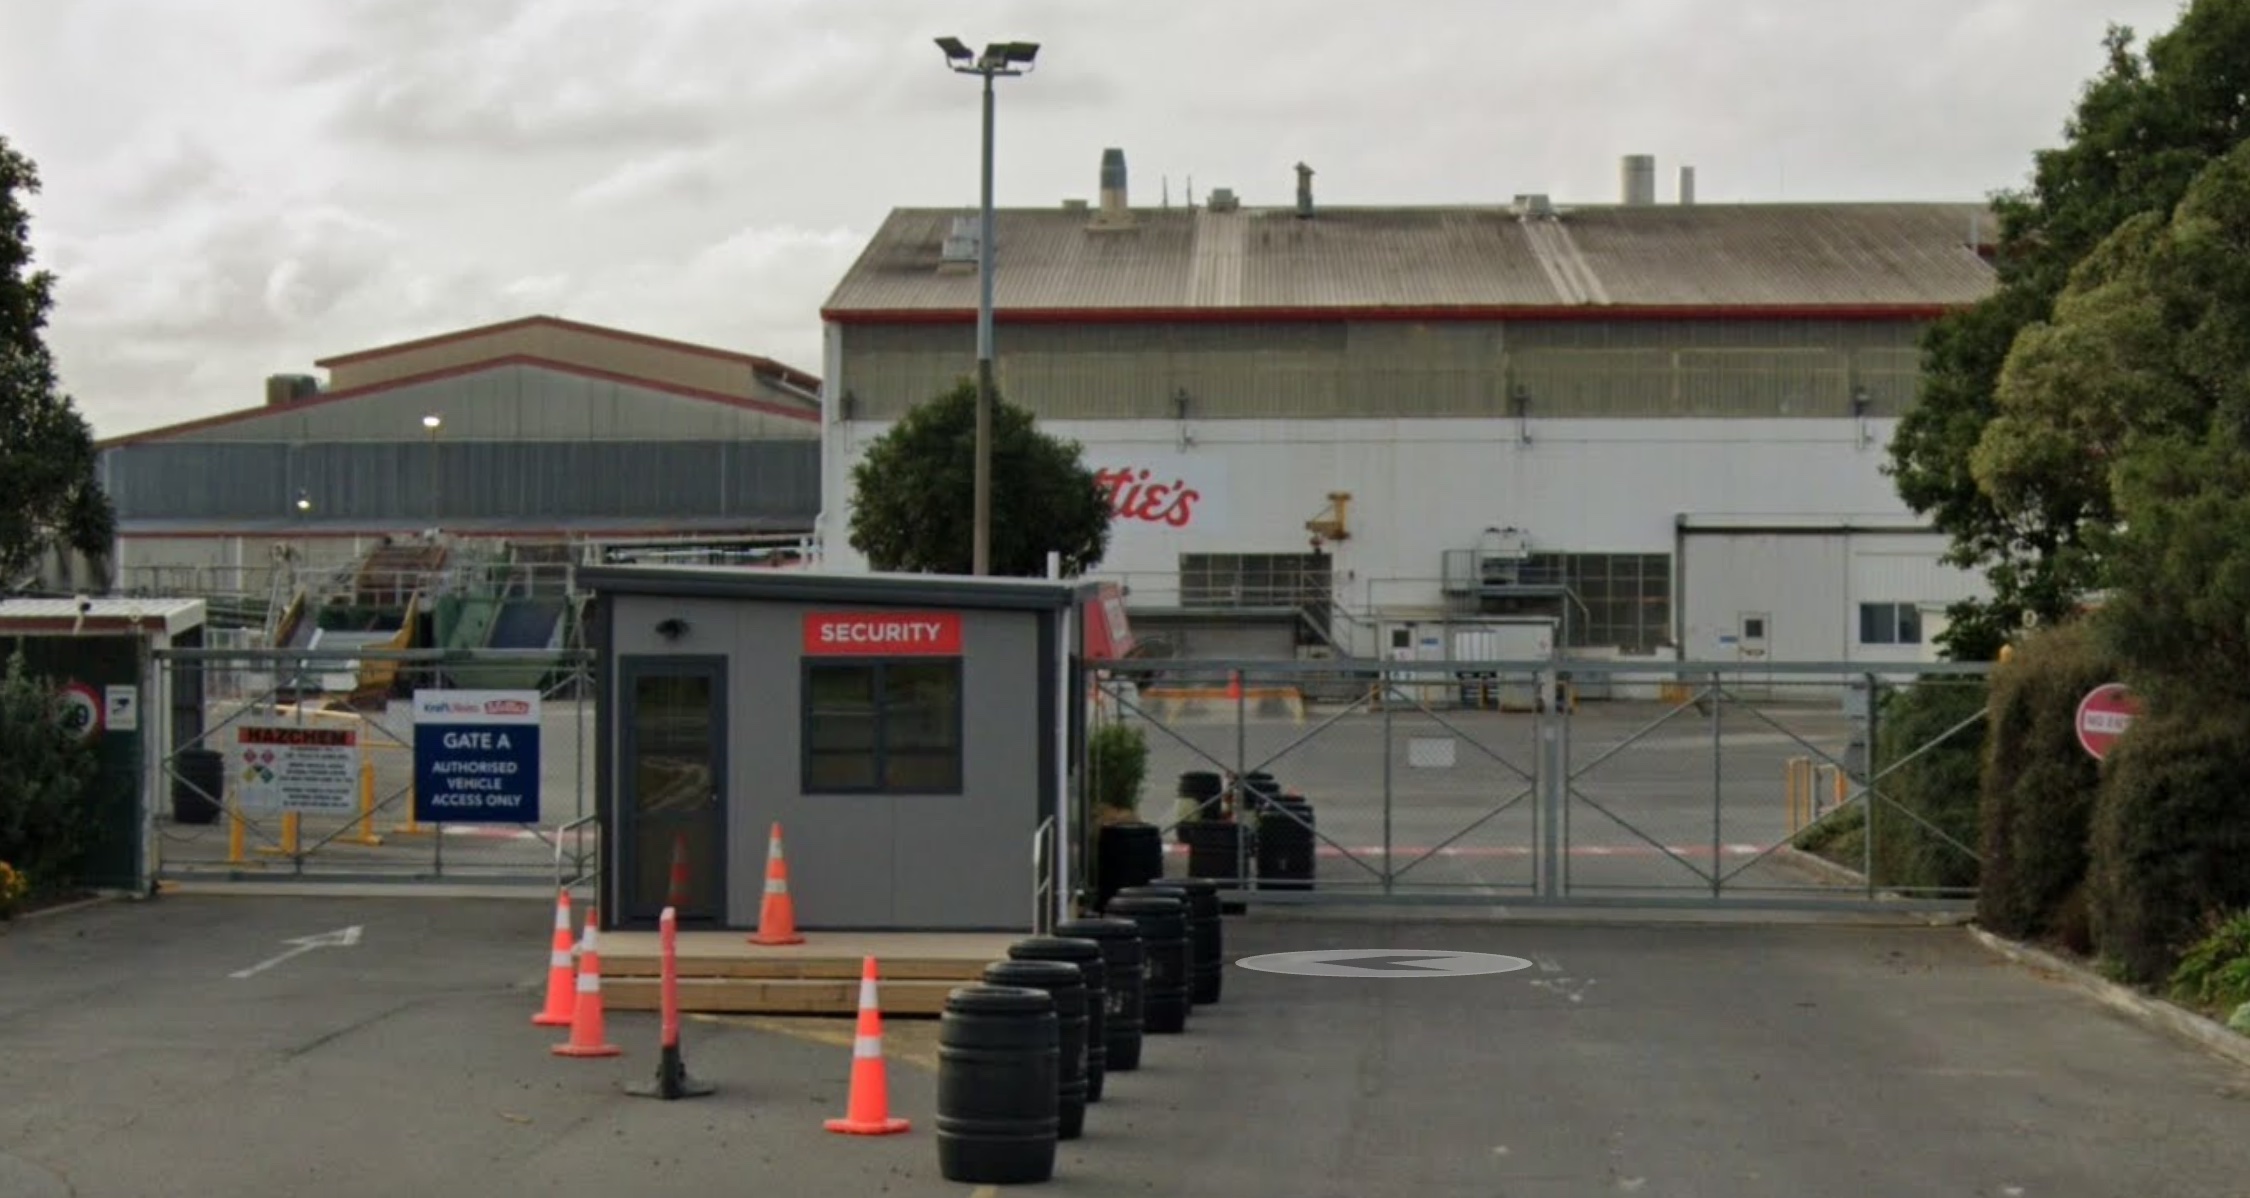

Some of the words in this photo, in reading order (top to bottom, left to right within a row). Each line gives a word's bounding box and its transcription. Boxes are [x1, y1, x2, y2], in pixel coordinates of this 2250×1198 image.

[1092, 467, 1199, 528] ttie's
[820, 622, 941, 643] SECURITY
[249, 727, 346, 746] HAZCHEM
[443, 732, 493, 749] GATE
[497, 733, 512, 749] A
[432, 761, 518, 774] AUTHORISED
[446, 777, 503, 790] VEHICLE
[431, 793, 484, 807] ACCESS
[486, 794, 523, 807] ONLY
